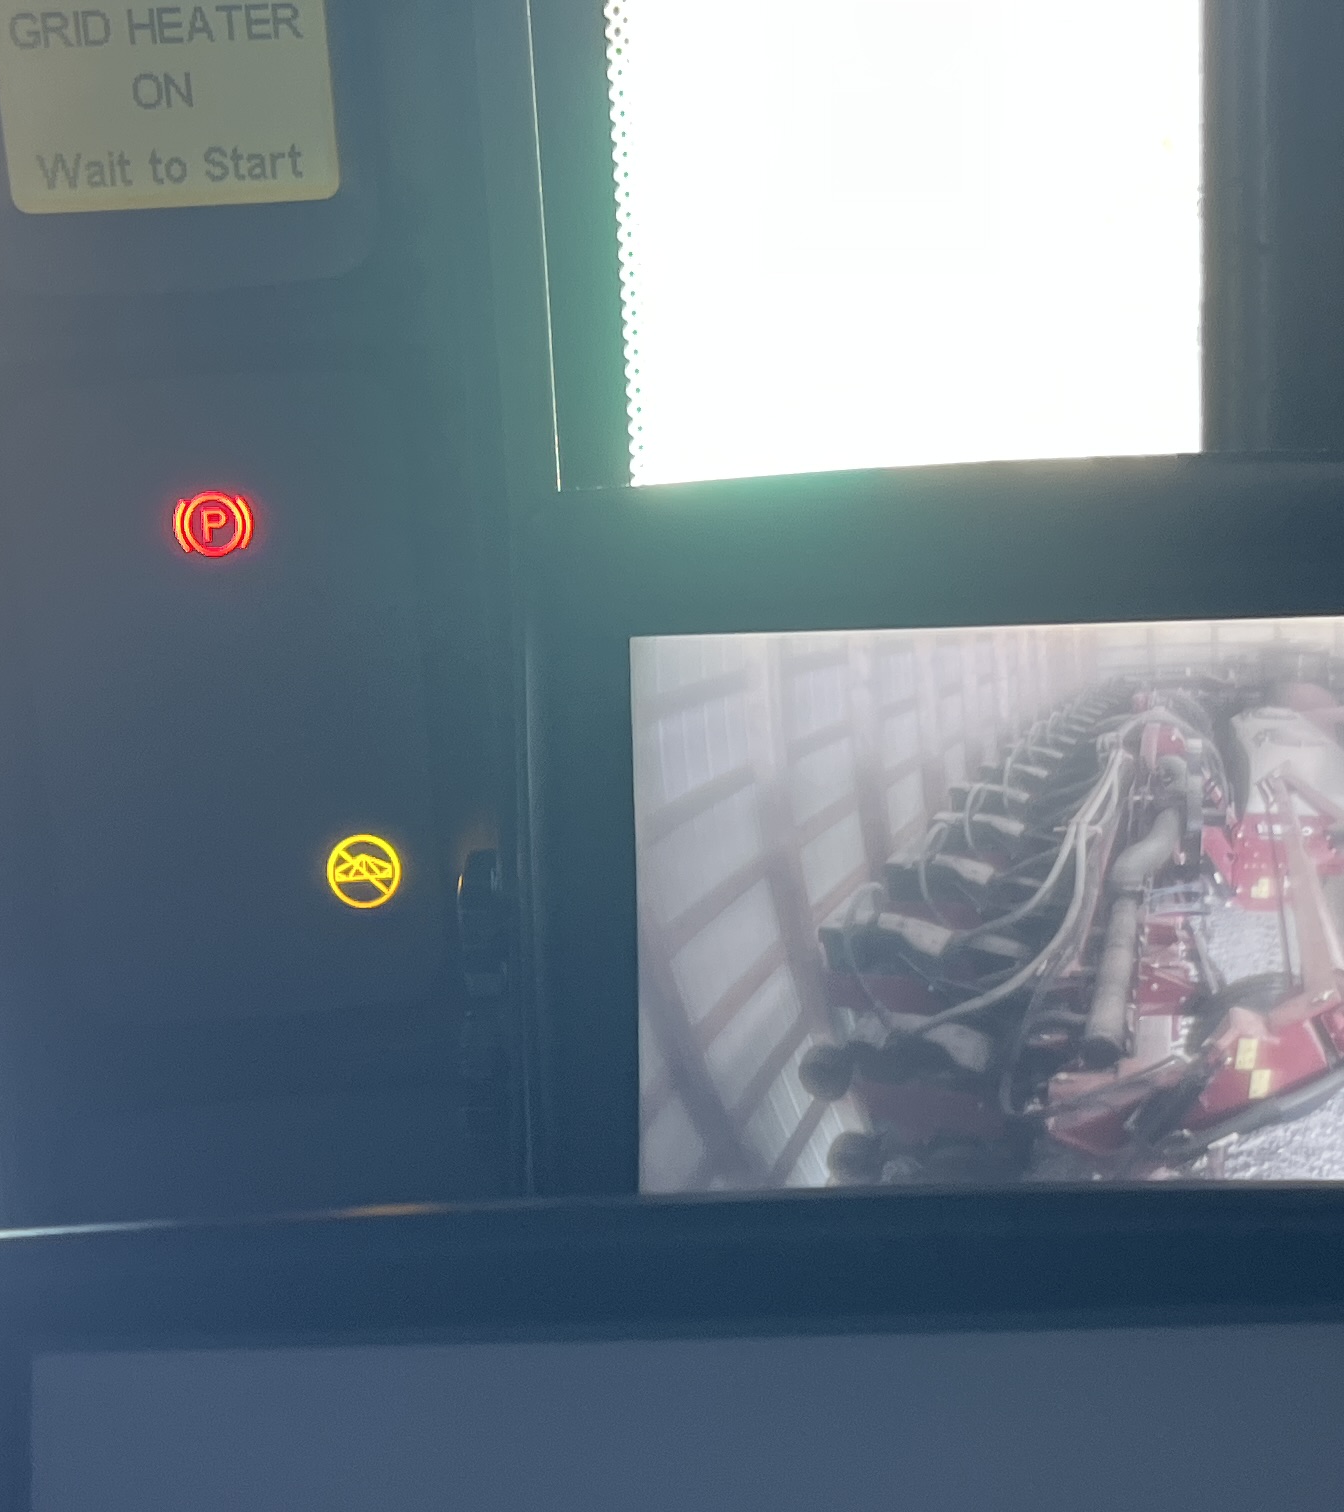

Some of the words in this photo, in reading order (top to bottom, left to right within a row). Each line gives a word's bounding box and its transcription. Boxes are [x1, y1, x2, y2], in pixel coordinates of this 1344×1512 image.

[9, 10, 112, 50] GRID
[126, 3, 304, 46] HEATER
[131, 71, 195, 110] ON
[35, 150, 133, 191] Wait
[148, 147, 188, 185] to
[203, 143, 304, 184] Start
